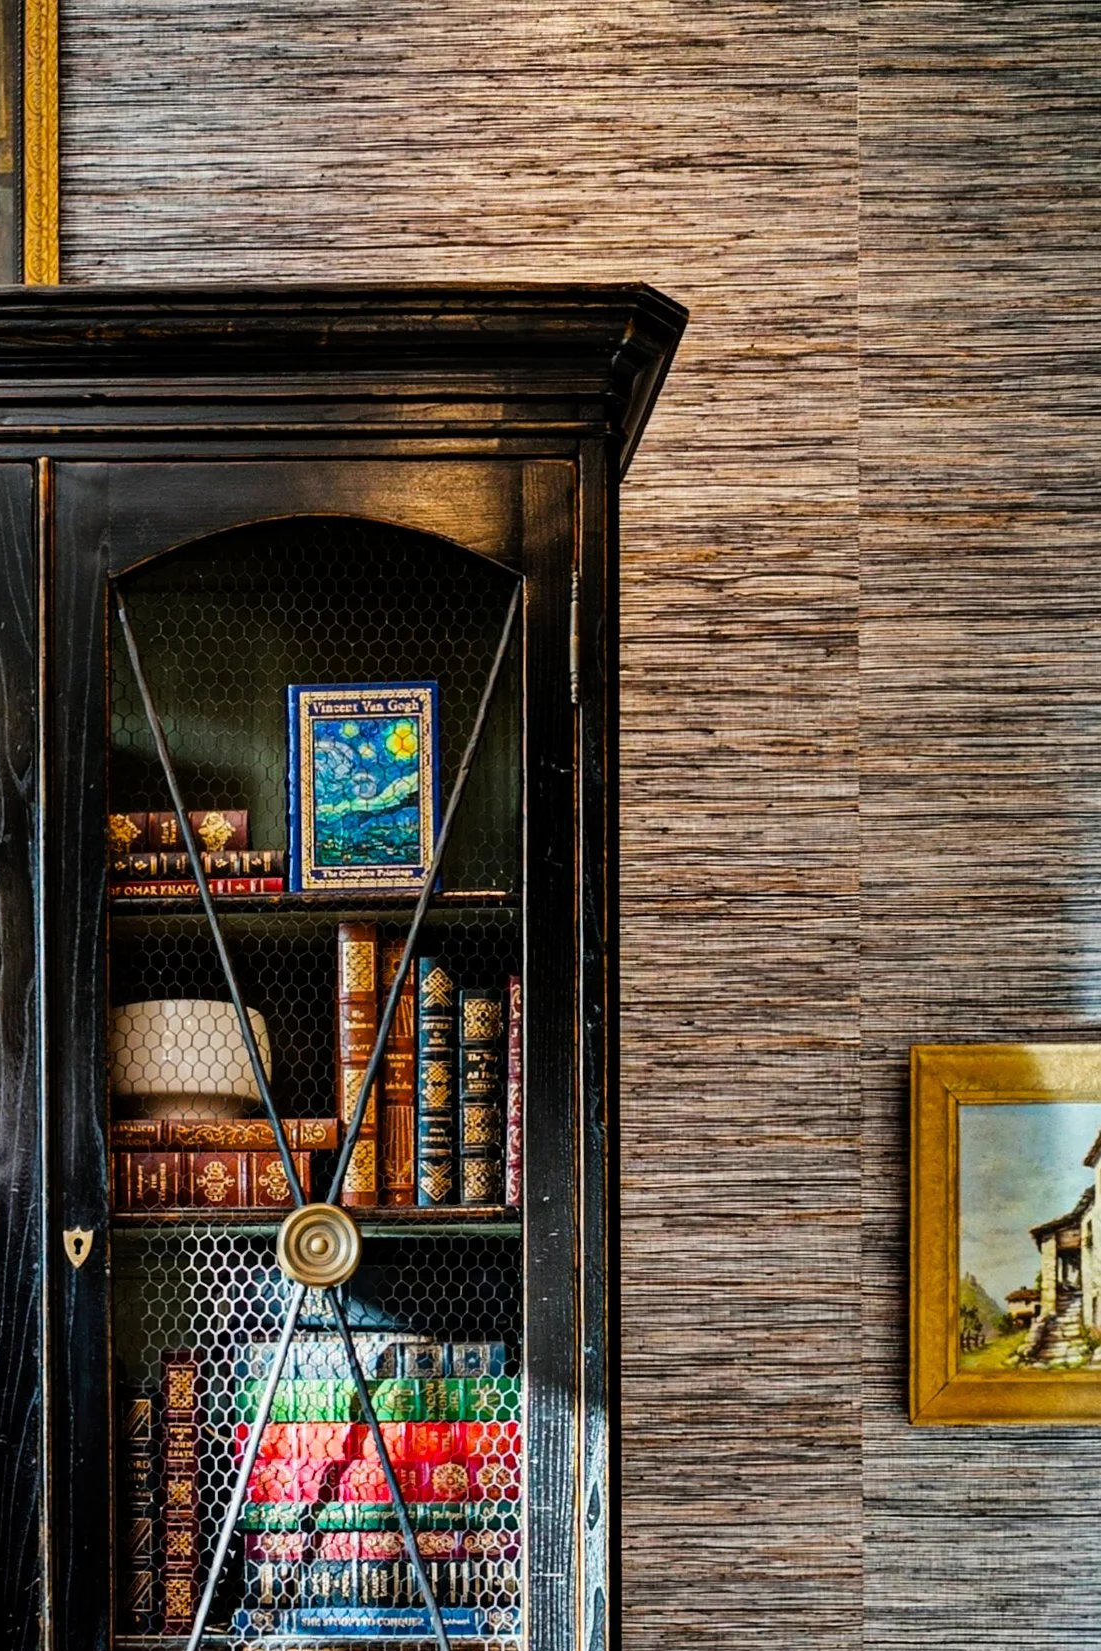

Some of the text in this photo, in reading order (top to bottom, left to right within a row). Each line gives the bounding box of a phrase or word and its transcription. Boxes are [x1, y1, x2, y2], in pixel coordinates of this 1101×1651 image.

[313, 699, 420, 713] Vincent Van Gogh
[323, 870, 338, 878] The
[124, 883, 158, 896] OMAR
[468, 1053, 481, 1061] The
[467, 1071, 480, 1079] All
